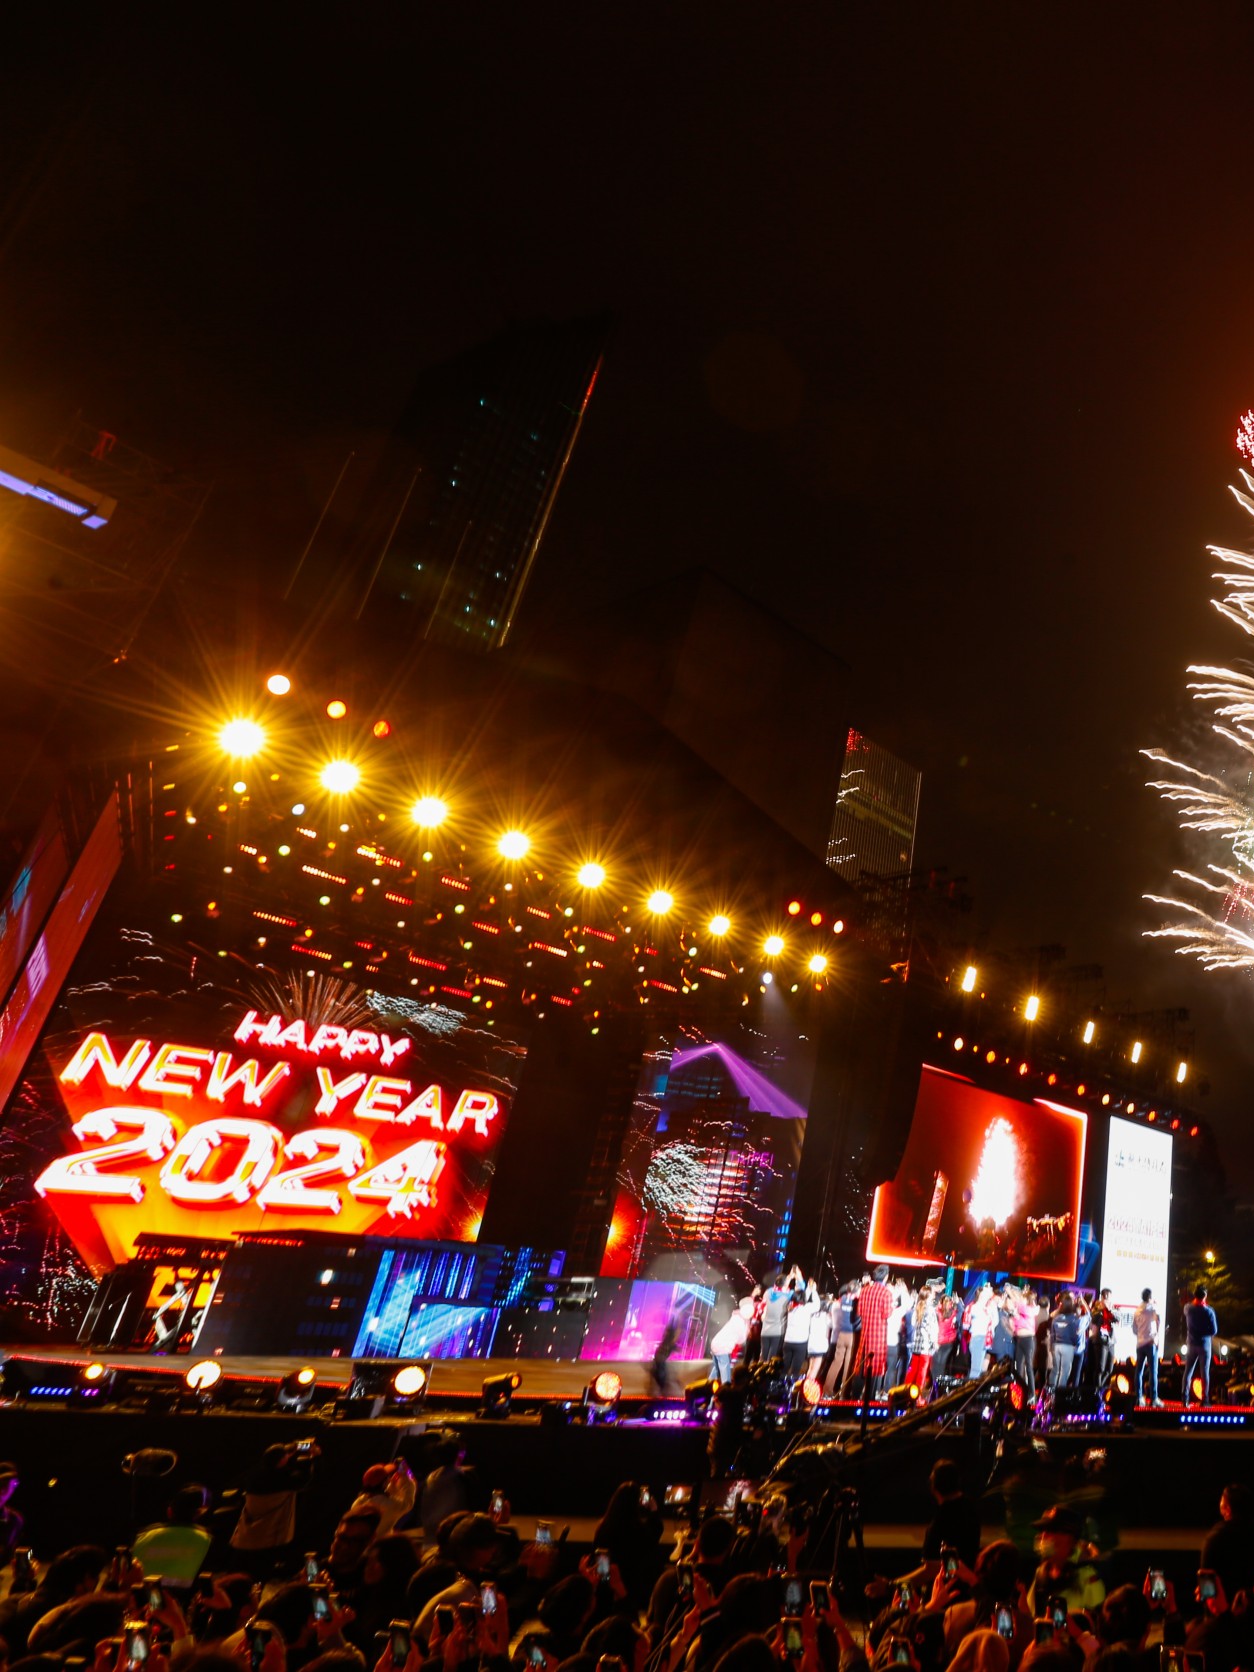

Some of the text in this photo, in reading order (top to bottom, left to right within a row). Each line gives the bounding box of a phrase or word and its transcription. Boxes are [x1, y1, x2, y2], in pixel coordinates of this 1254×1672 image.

[59, 1032, 499, 1137] NEW YEAR
[233, 1010, 411, 1066] HAPPY
[34, 1105, 447, 1219] 2024
